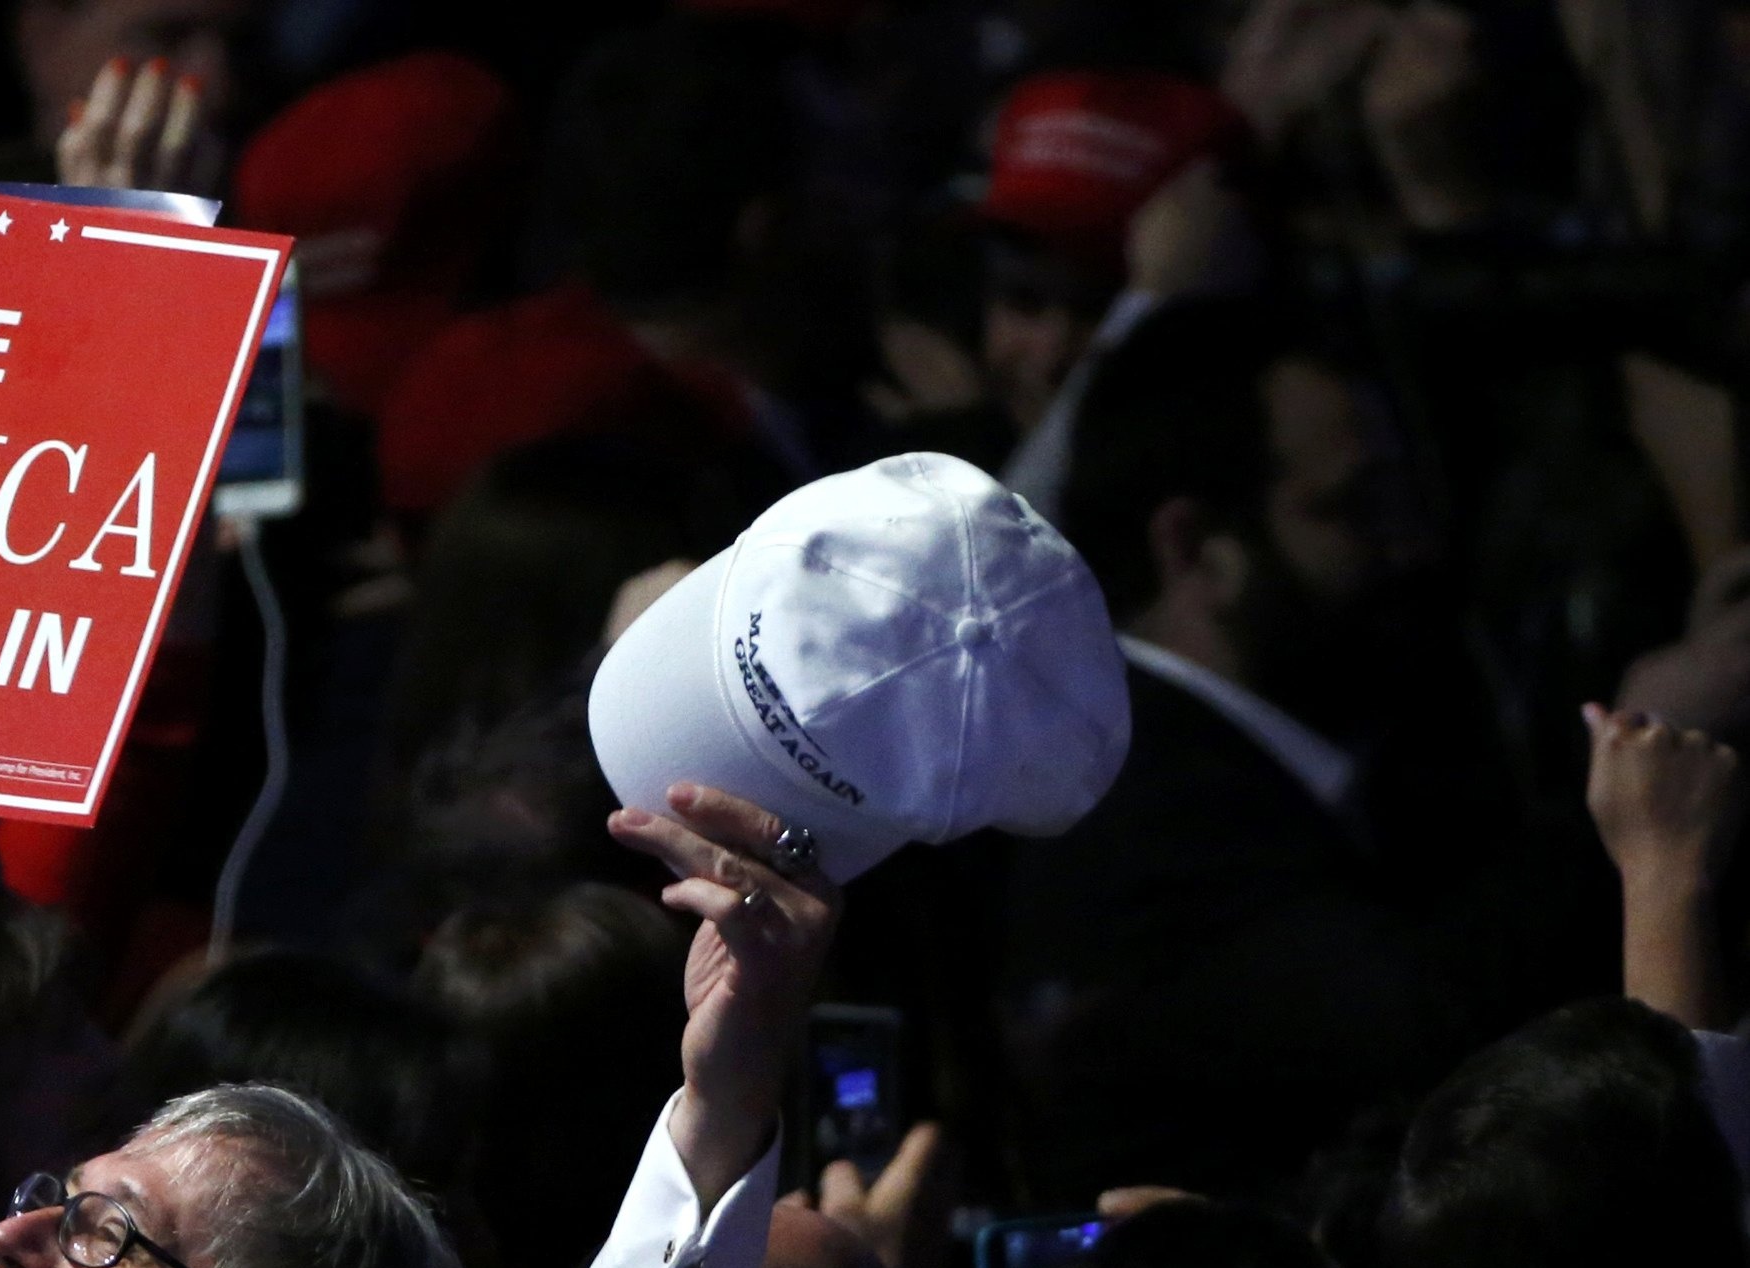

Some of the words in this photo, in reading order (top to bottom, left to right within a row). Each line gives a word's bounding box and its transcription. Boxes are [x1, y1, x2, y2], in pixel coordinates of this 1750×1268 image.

[735, 637, 787, 733] GREAT
[779, 739, 866, 805] AGAIN
[16, 763, 28, 774] for
